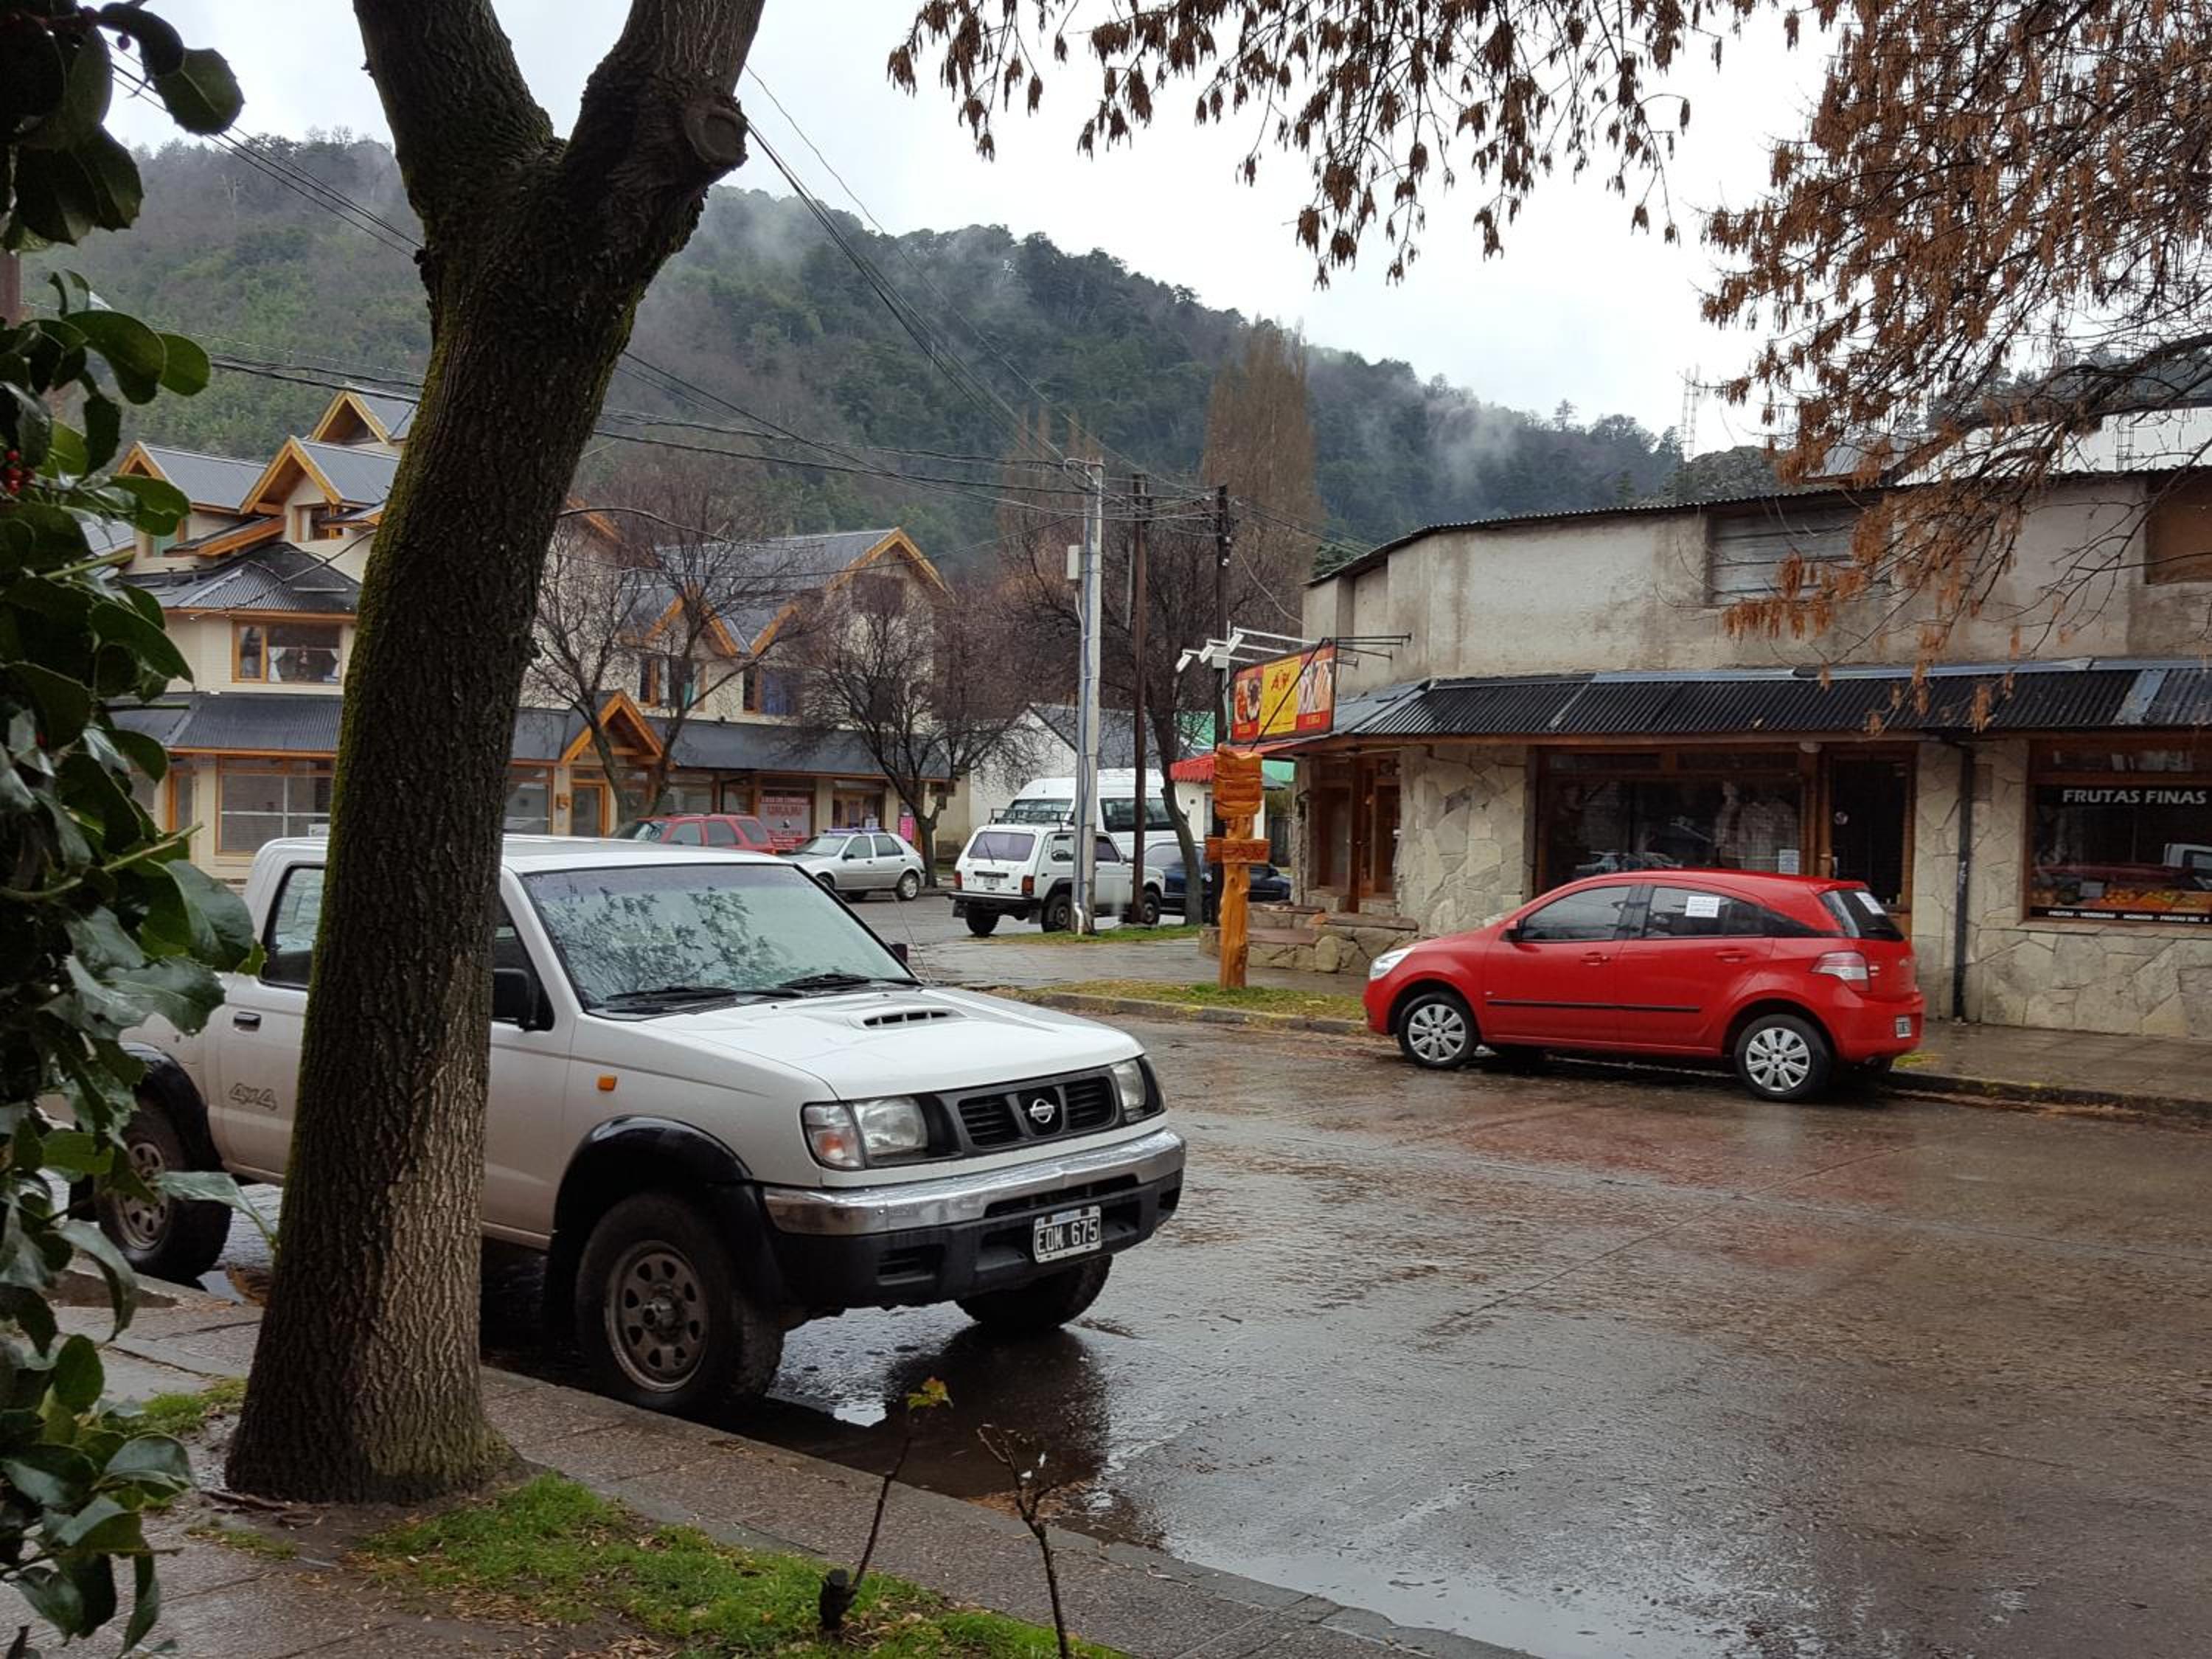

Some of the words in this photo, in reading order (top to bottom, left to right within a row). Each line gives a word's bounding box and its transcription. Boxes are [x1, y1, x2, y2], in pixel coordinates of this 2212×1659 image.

[2062, 790, 2140, 803] FRUTAS
[2145, 790, 2207, 804] FINAS
[1071, 1218, 1098, 1245] 675
